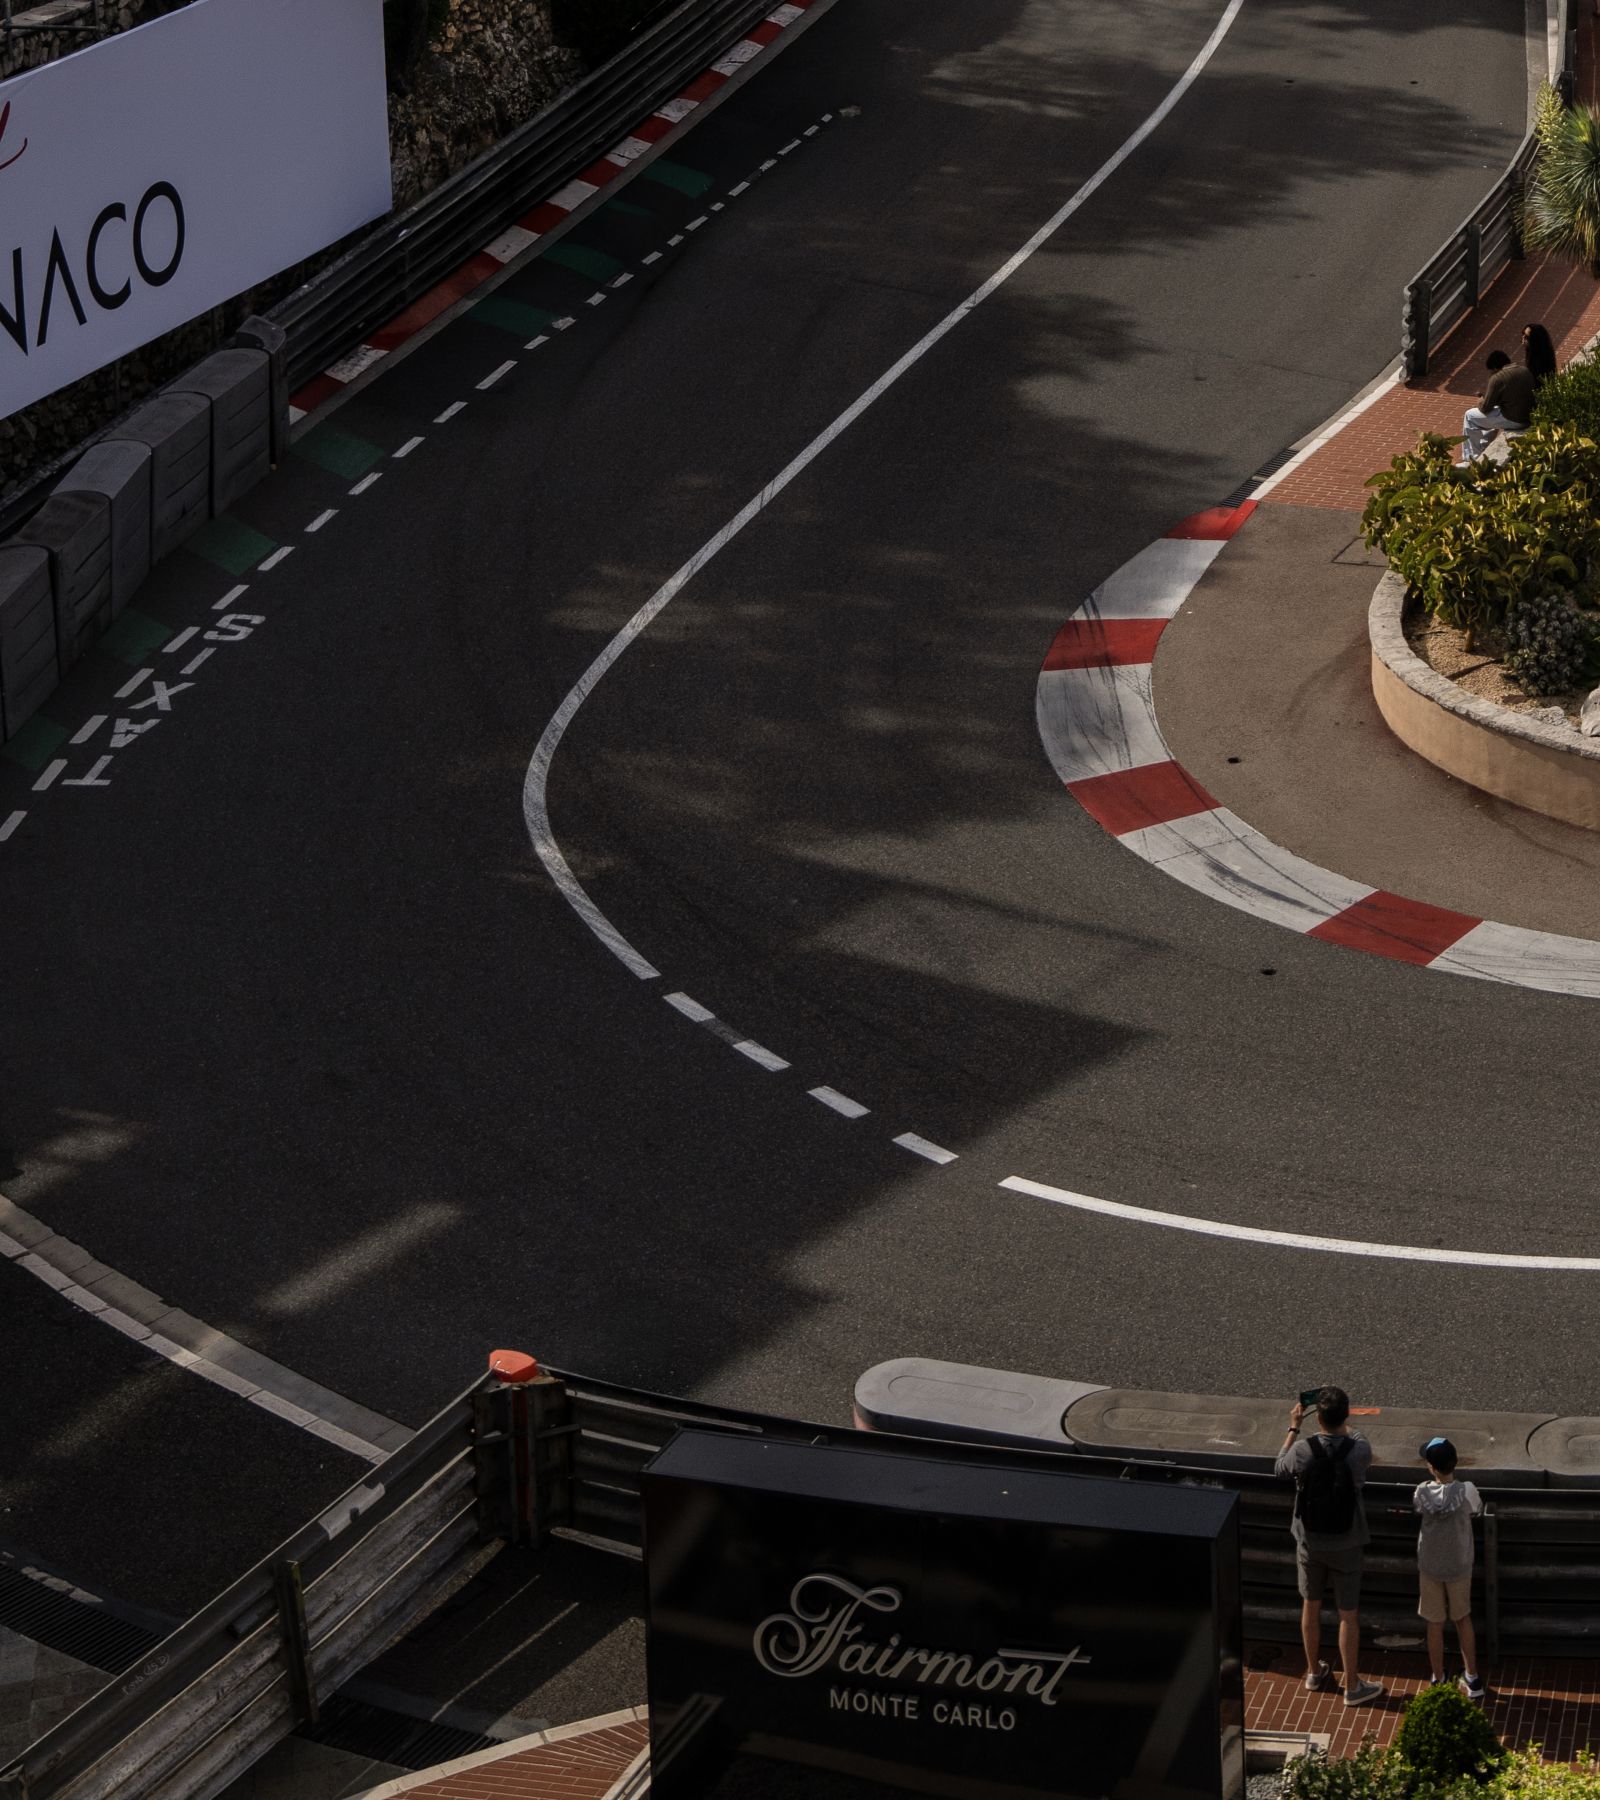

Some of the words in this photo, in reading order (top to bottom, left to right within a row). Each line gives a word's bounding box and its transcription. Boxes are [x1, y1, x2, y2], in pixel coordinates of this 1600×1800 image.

[61, 613, 267, 786] TAXIS
[753, 1573, 1092, 1706] Fairmont
[829, 1688, 919, 1720] MONTE
[932, 1702, 1016, 1732] CARLO
